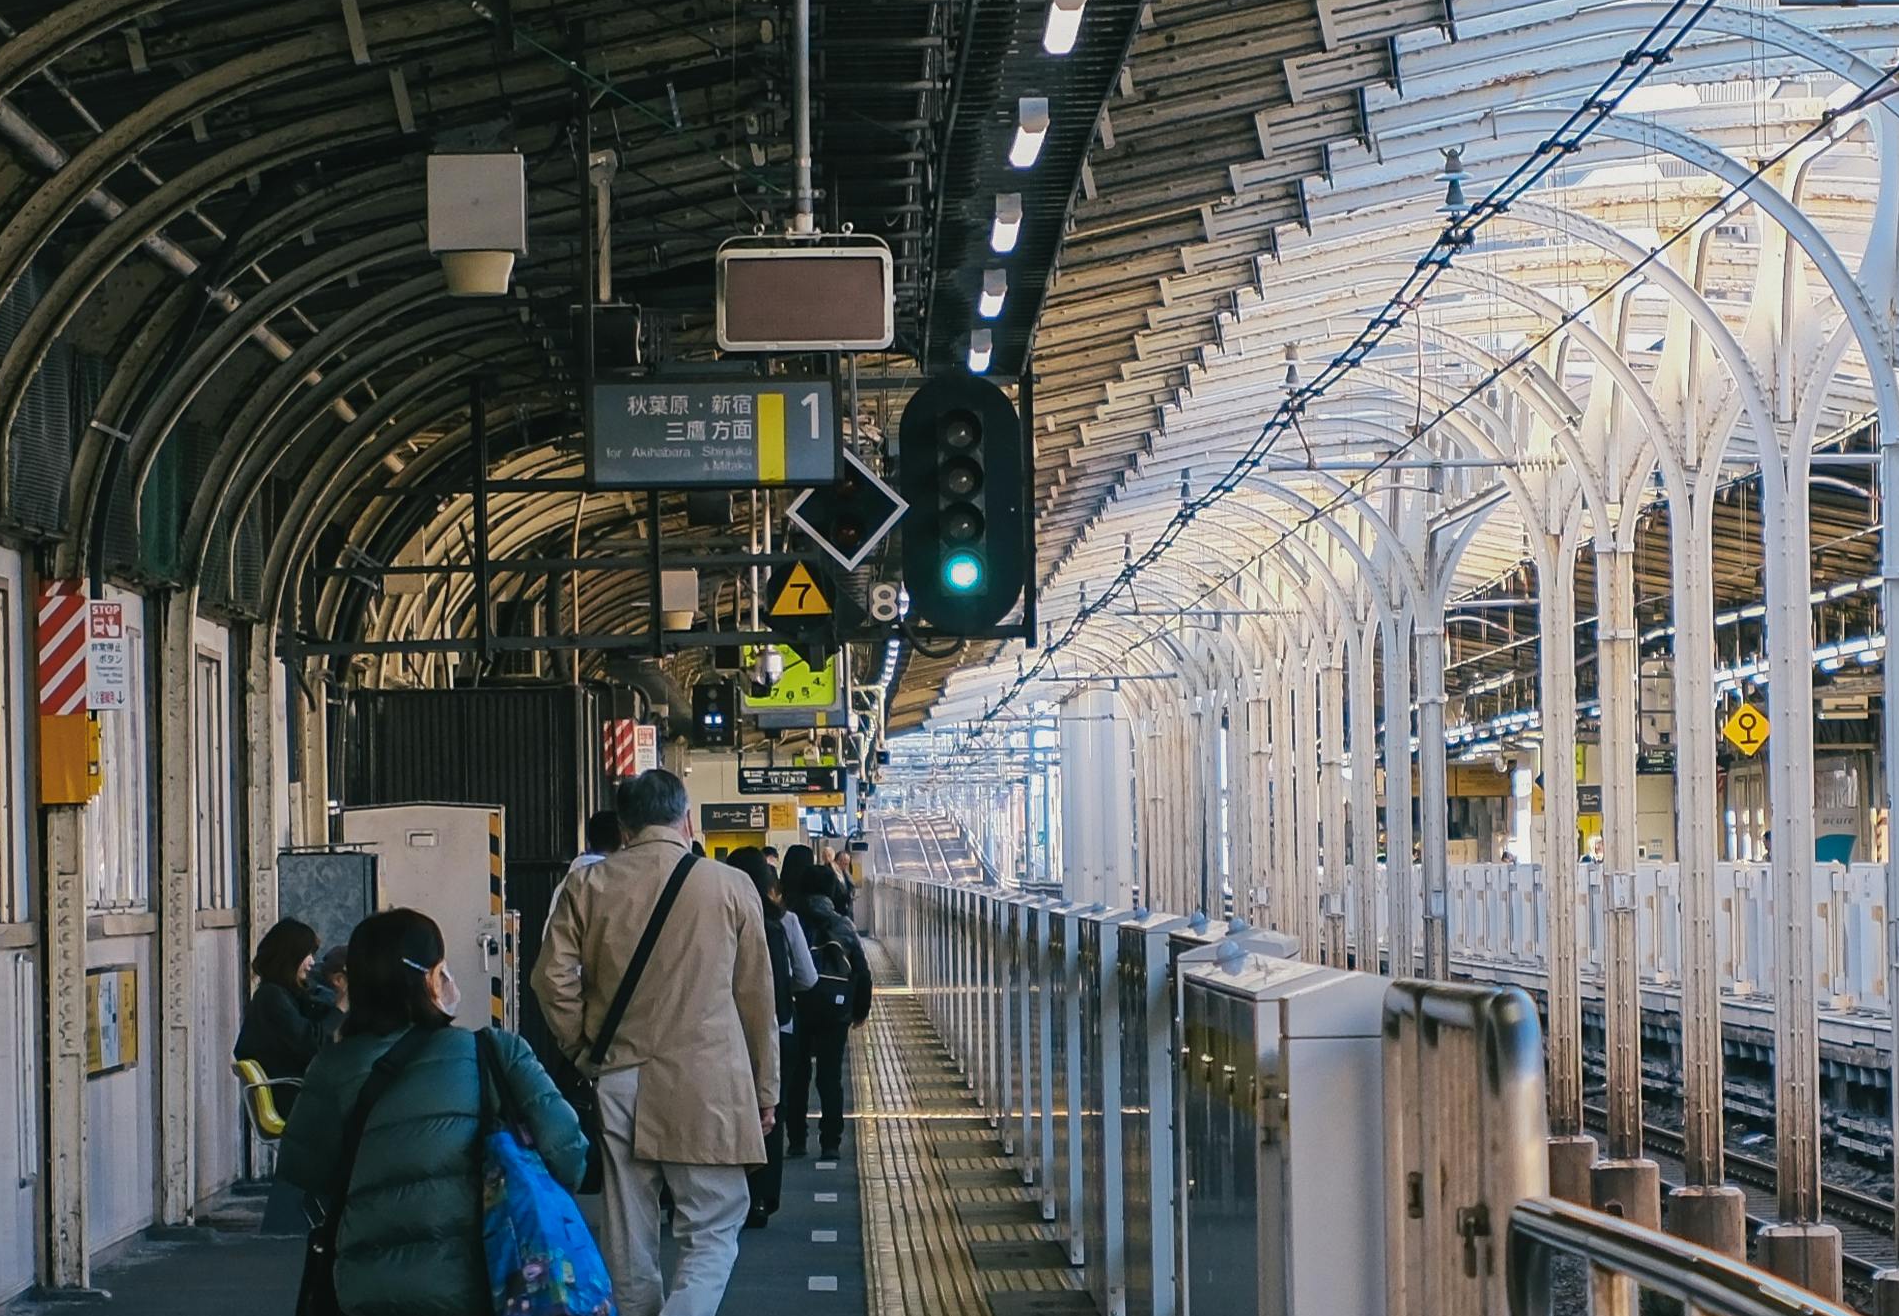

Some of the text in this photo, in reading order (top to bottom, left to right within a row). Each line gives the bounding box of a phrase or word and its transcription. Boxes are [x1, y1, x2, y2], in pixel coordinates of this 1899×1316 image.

[627, 394, 752, 417] 秋葉原・新宿
[801, 392, 820, 440] 1
[606, 446, 623, 459] for
[712, 460, 752, 472] Mitaka
[789, 583, 812, 610] 7
[871, 583, 898, 622] 8
[92, 605, 121, 615] STOP
[829, 769, 839, 790] 1
